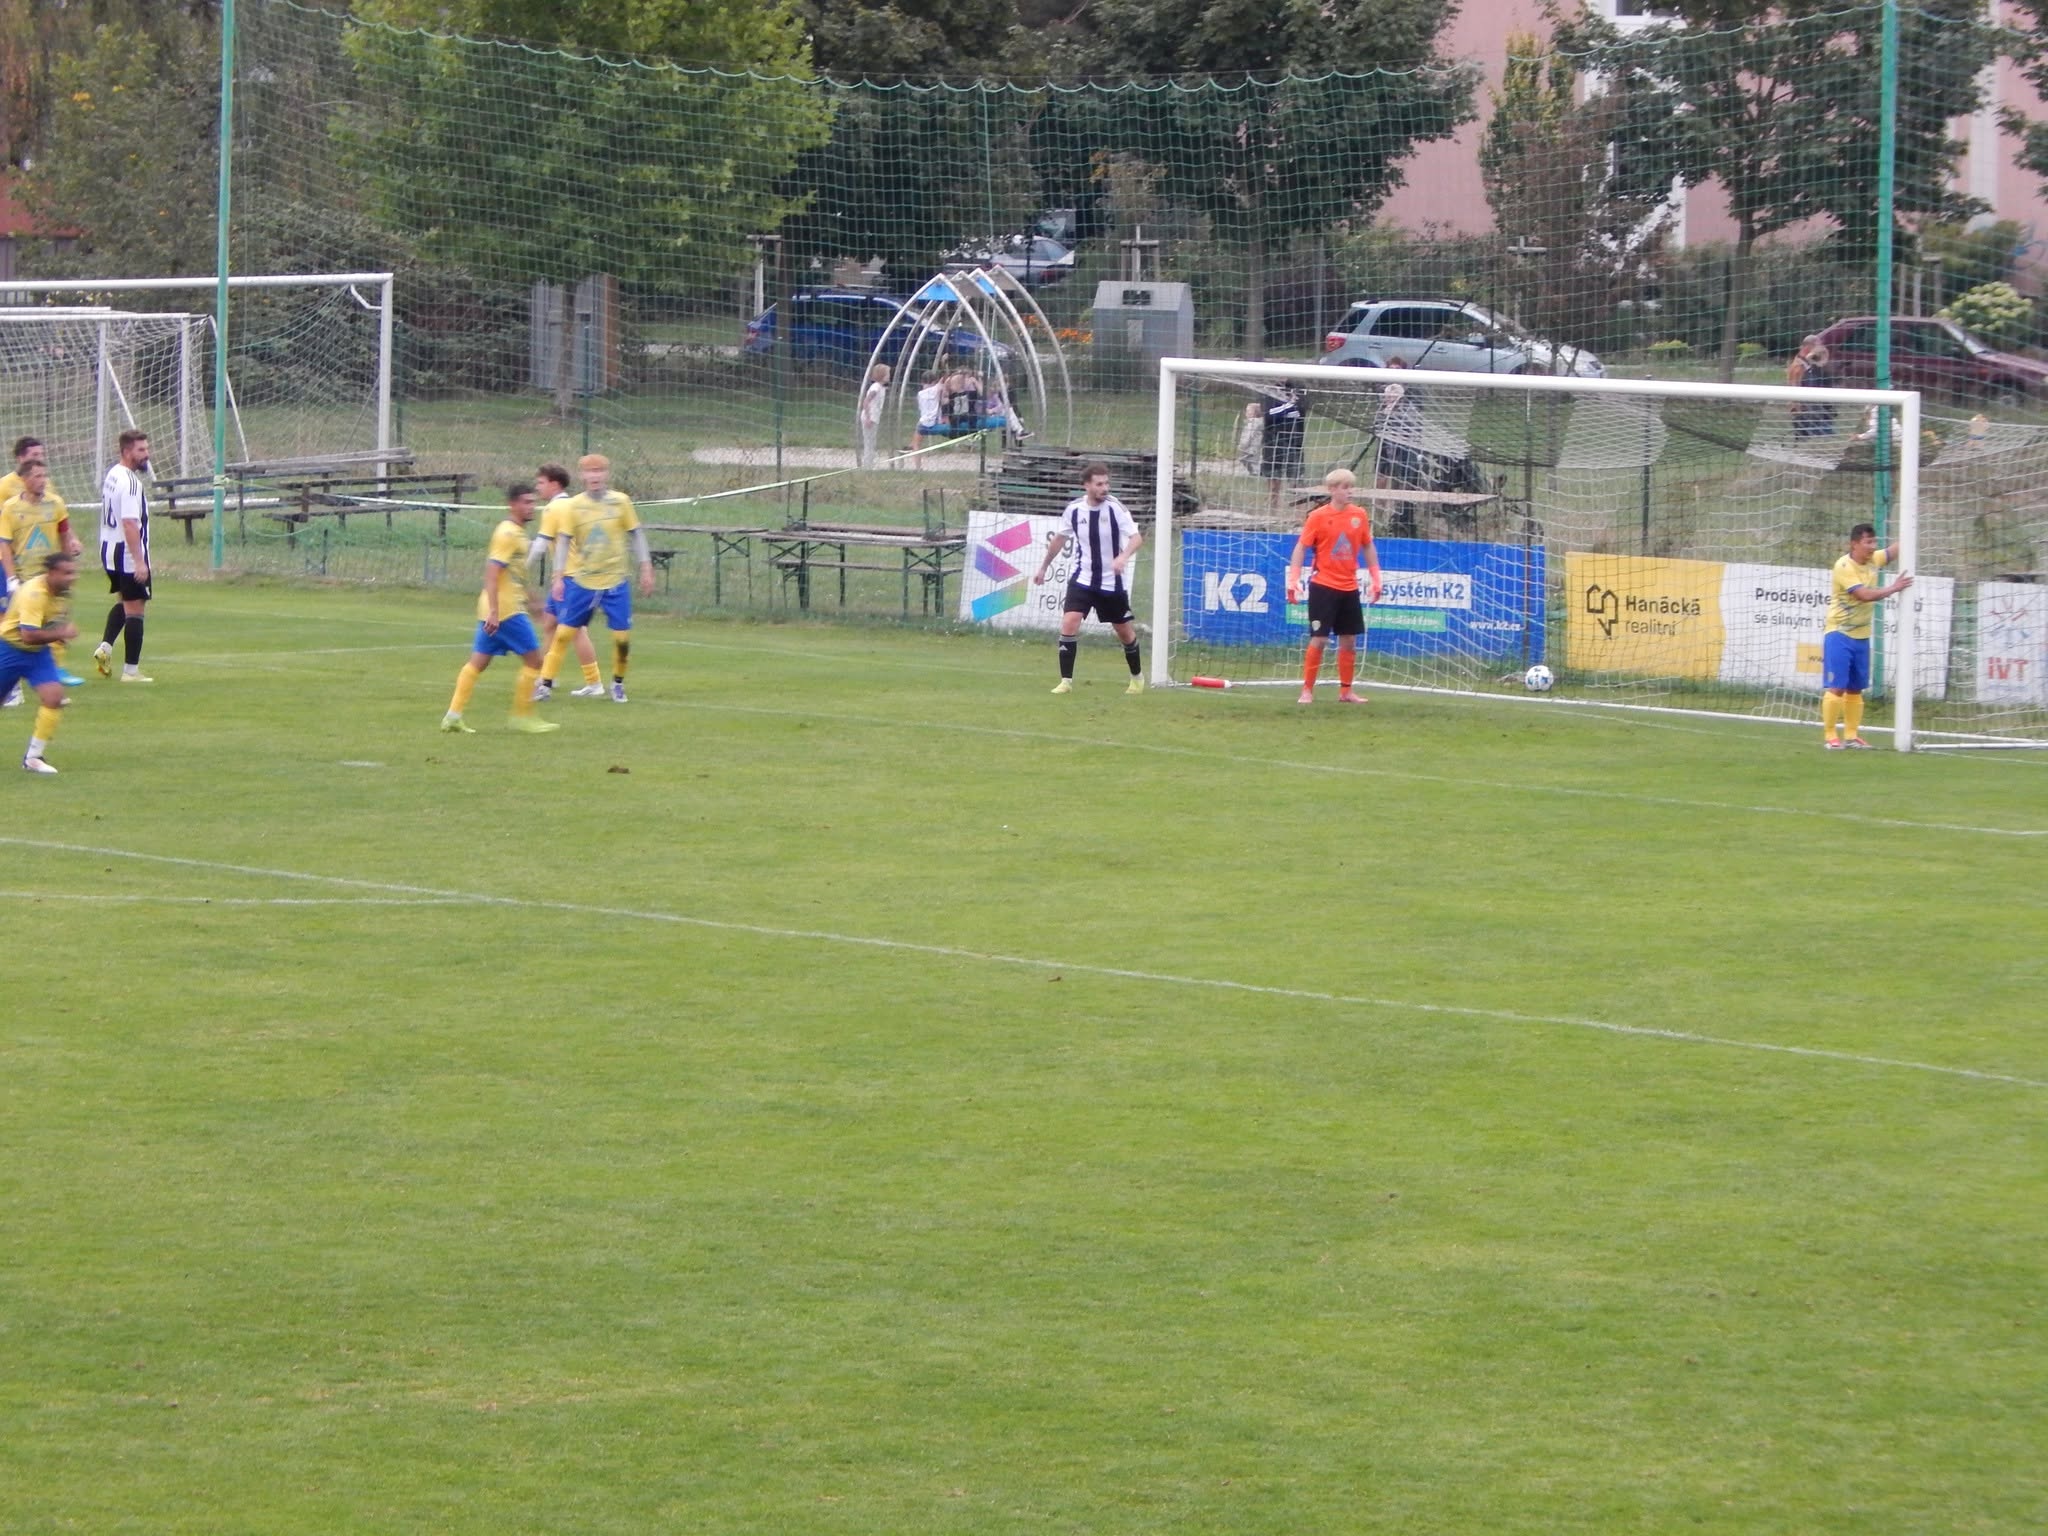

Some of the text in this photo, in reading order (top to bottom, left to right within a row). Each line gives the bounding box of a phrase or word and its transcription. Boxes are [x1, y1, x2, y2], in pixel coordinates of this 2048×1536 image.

[1204, 571, 1268, 613] K2
[1383, 582, 1438, 601] systém
[1443, 582, 1465, 599] K2
[1755, 587, 1832, 608] Prodávejte
[1625, 619, 1676, 636] realitní
[1754, 613, 1768, 624] se
